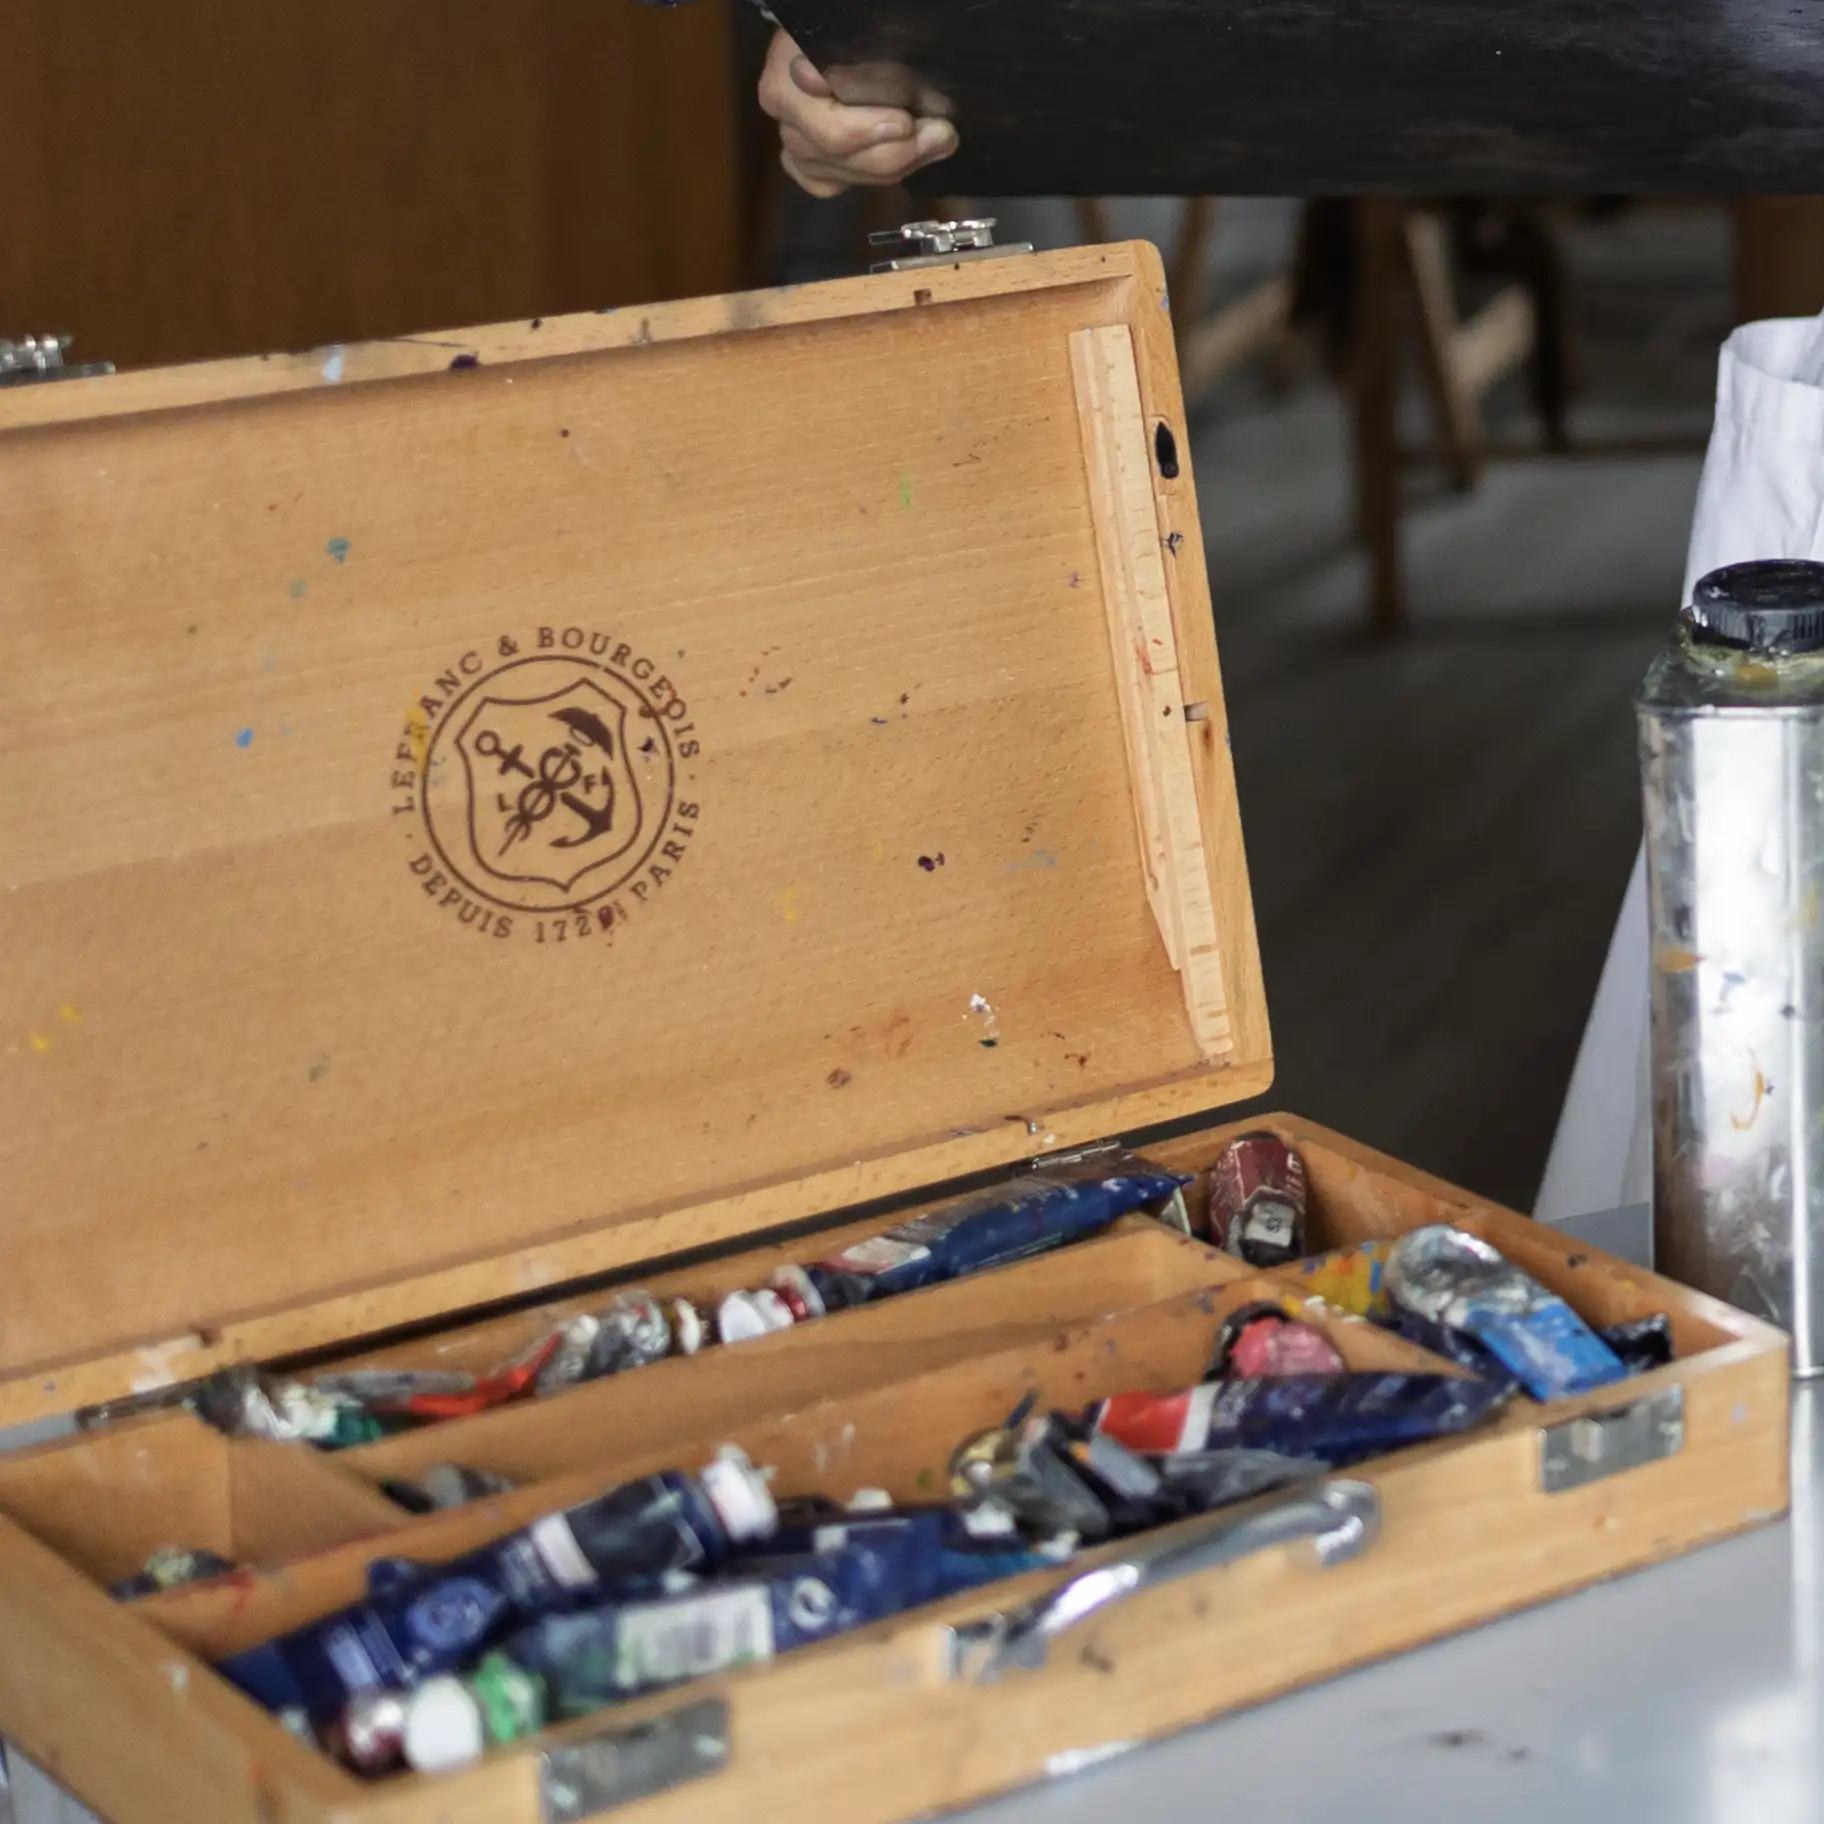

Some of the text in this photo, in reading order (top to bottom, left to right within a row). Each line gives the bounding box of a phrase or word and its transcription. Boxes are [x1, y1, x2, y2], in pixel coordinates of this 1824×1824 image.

[392, 626, 700, 817] LEFRANC & BOURGEOIS
[409, 853, 513, 939] DEPUIS
[630, 801, 700, 904] PARIS
